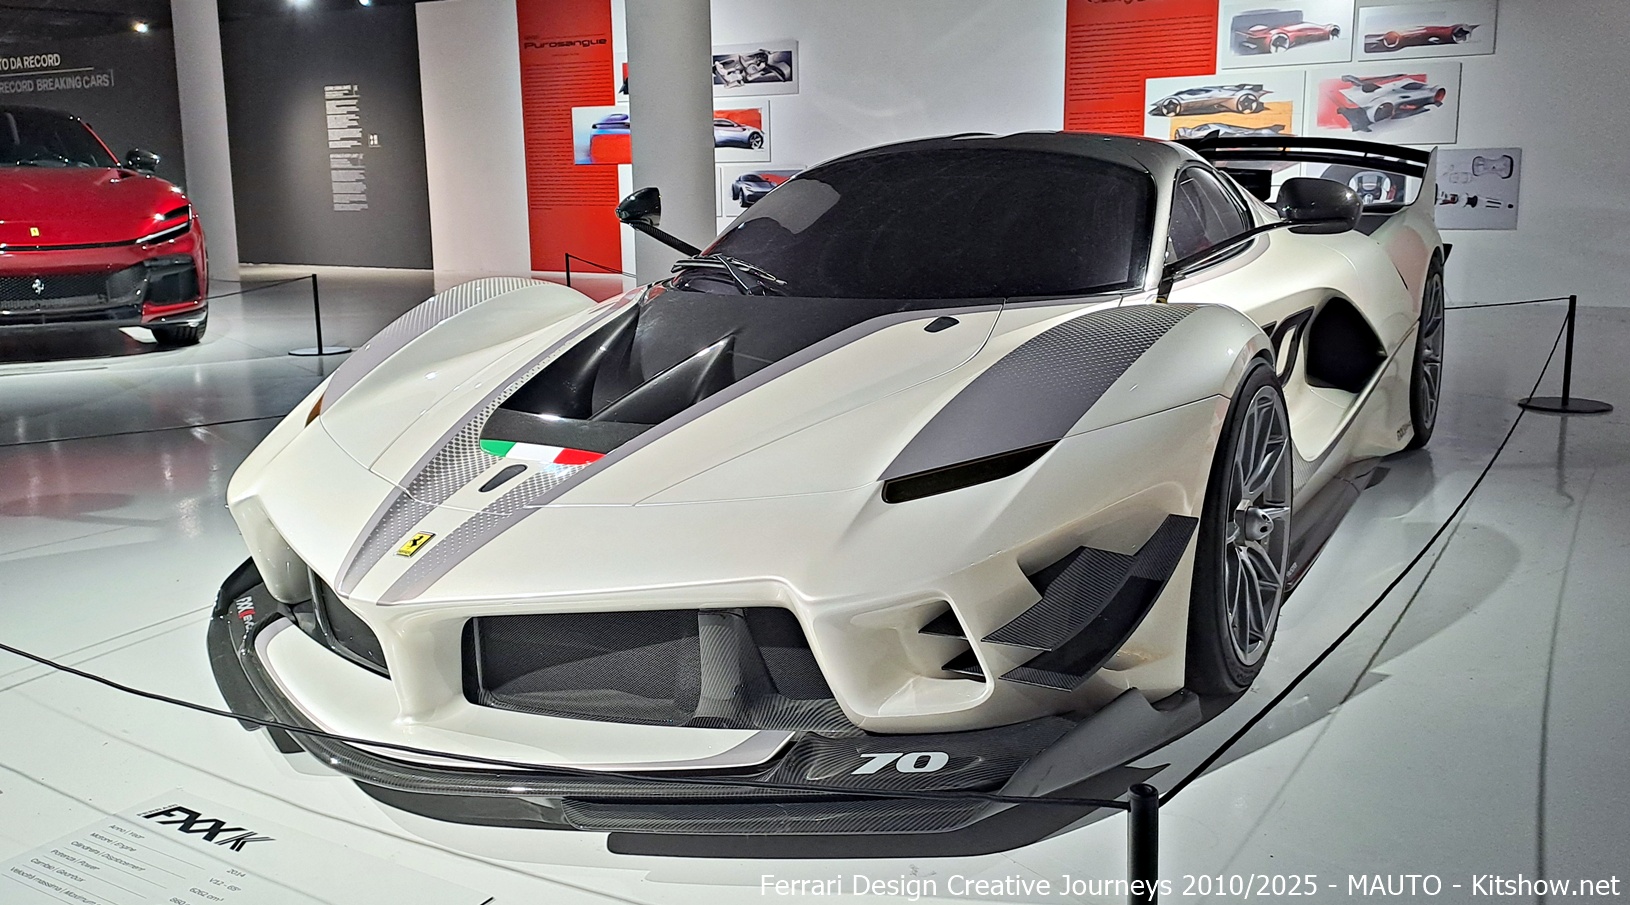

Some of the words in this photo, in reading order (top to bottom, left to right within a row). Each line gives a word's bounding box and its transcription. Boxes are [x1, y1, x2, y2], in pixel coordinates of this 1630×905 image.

[524, 39, 607, 49] Purosangue
[10, 57, 24, 70] DA
[23, 54, 61, 69] RECORD
[0, 80, 34, 94] RECORD
[36, 75, 82, 91] BREAKING
[83, 74, 110, 88] CARS
[851, 752, 949, 775] 70
